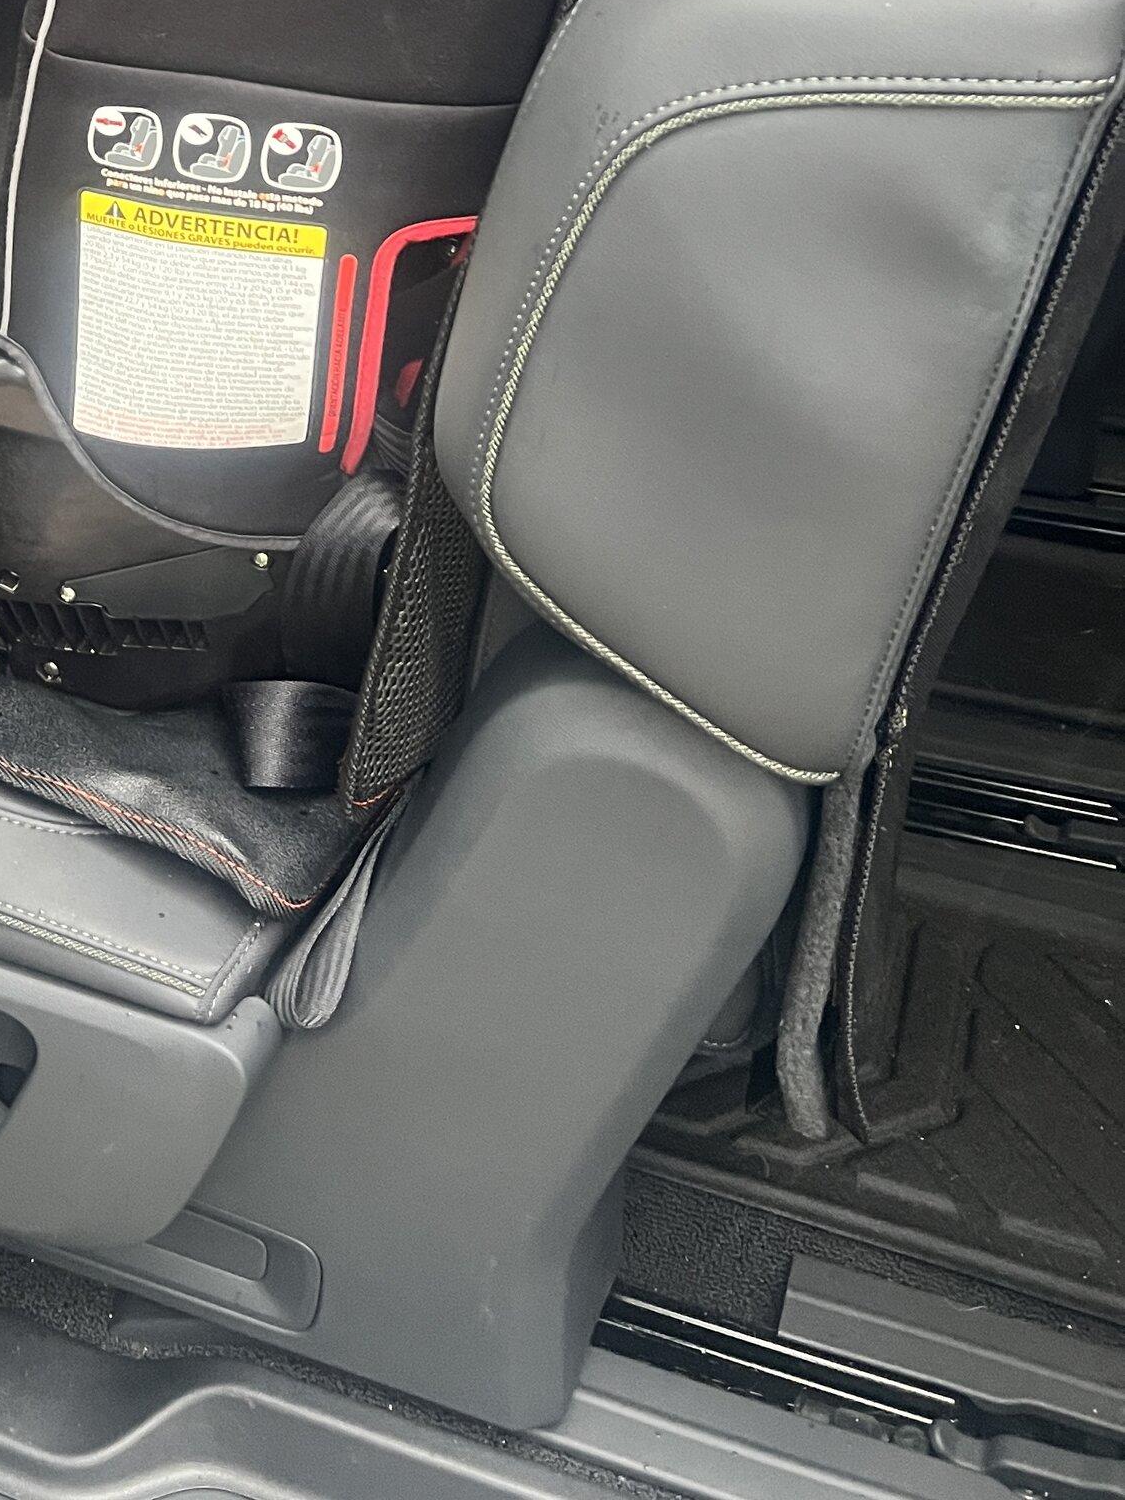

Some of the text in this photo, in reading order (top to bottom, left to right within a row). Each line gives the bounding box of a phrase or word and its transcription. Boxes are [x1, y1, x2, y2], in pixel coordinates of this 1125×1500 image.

[166, 189, 185, 199] que
[233, 196, 247, 205] de
[86, 212, 126, 229] MUERTE
[137, 224, 186, 241] LESIONES
[188, 234, 231, 246] GRAVES
[232, 240, 274, 251] pueden
[133, 207, 299, 244] ADVERTENCIA!
